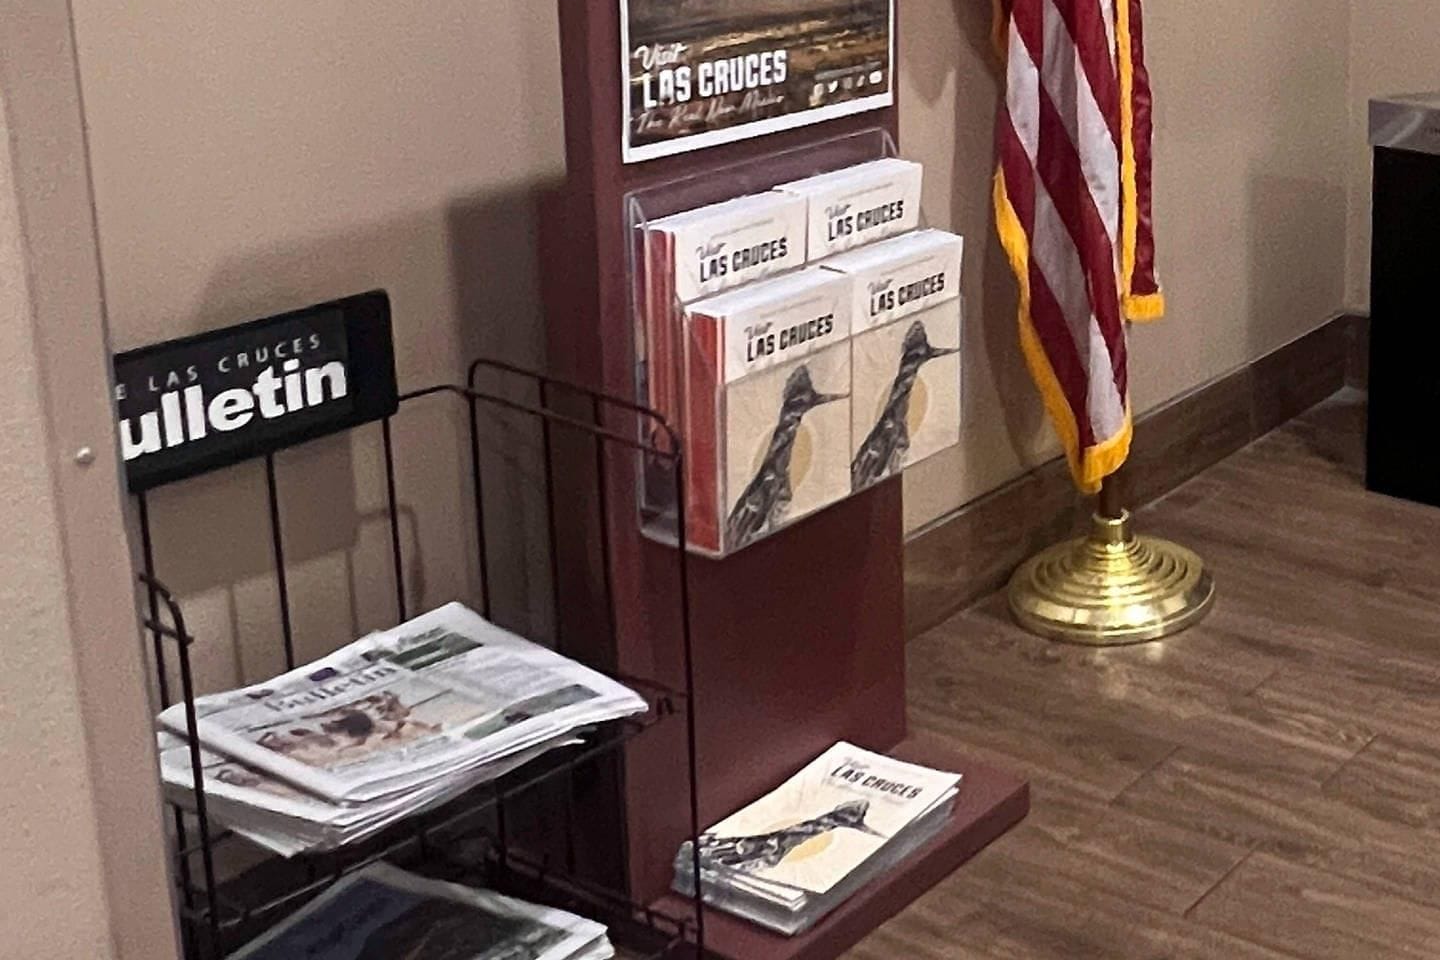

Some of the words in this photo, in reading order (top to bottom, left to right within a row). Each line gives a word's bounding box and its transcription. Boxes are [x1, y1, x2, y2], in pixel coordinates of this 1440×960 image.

[631, 42, 688, 70] Visit
[642, 65, 691, 109] LAS
[698, 49, 787, 98] CRUCES
[828, 215, 853, 241] LAS
[857, 199, 904, 232] CRUCES
[699, 254, 728, 283] LAS
[732, 236, 788, 272] CRUCES
[869, 289, 895, 316] LAS
[898, 272, 945, 306] CRUCES
[746, 333, 775, 361] LAS
[779, 313, 834, 352] CRUCES
[149, 365, 198, 392] LAS
[217, 333, 321, 373] CRUCES
[119, 358, 348, 462] ulletin
[831, 765, 863, 785] LAS
[862, 775, 923, 799] CRUCES
